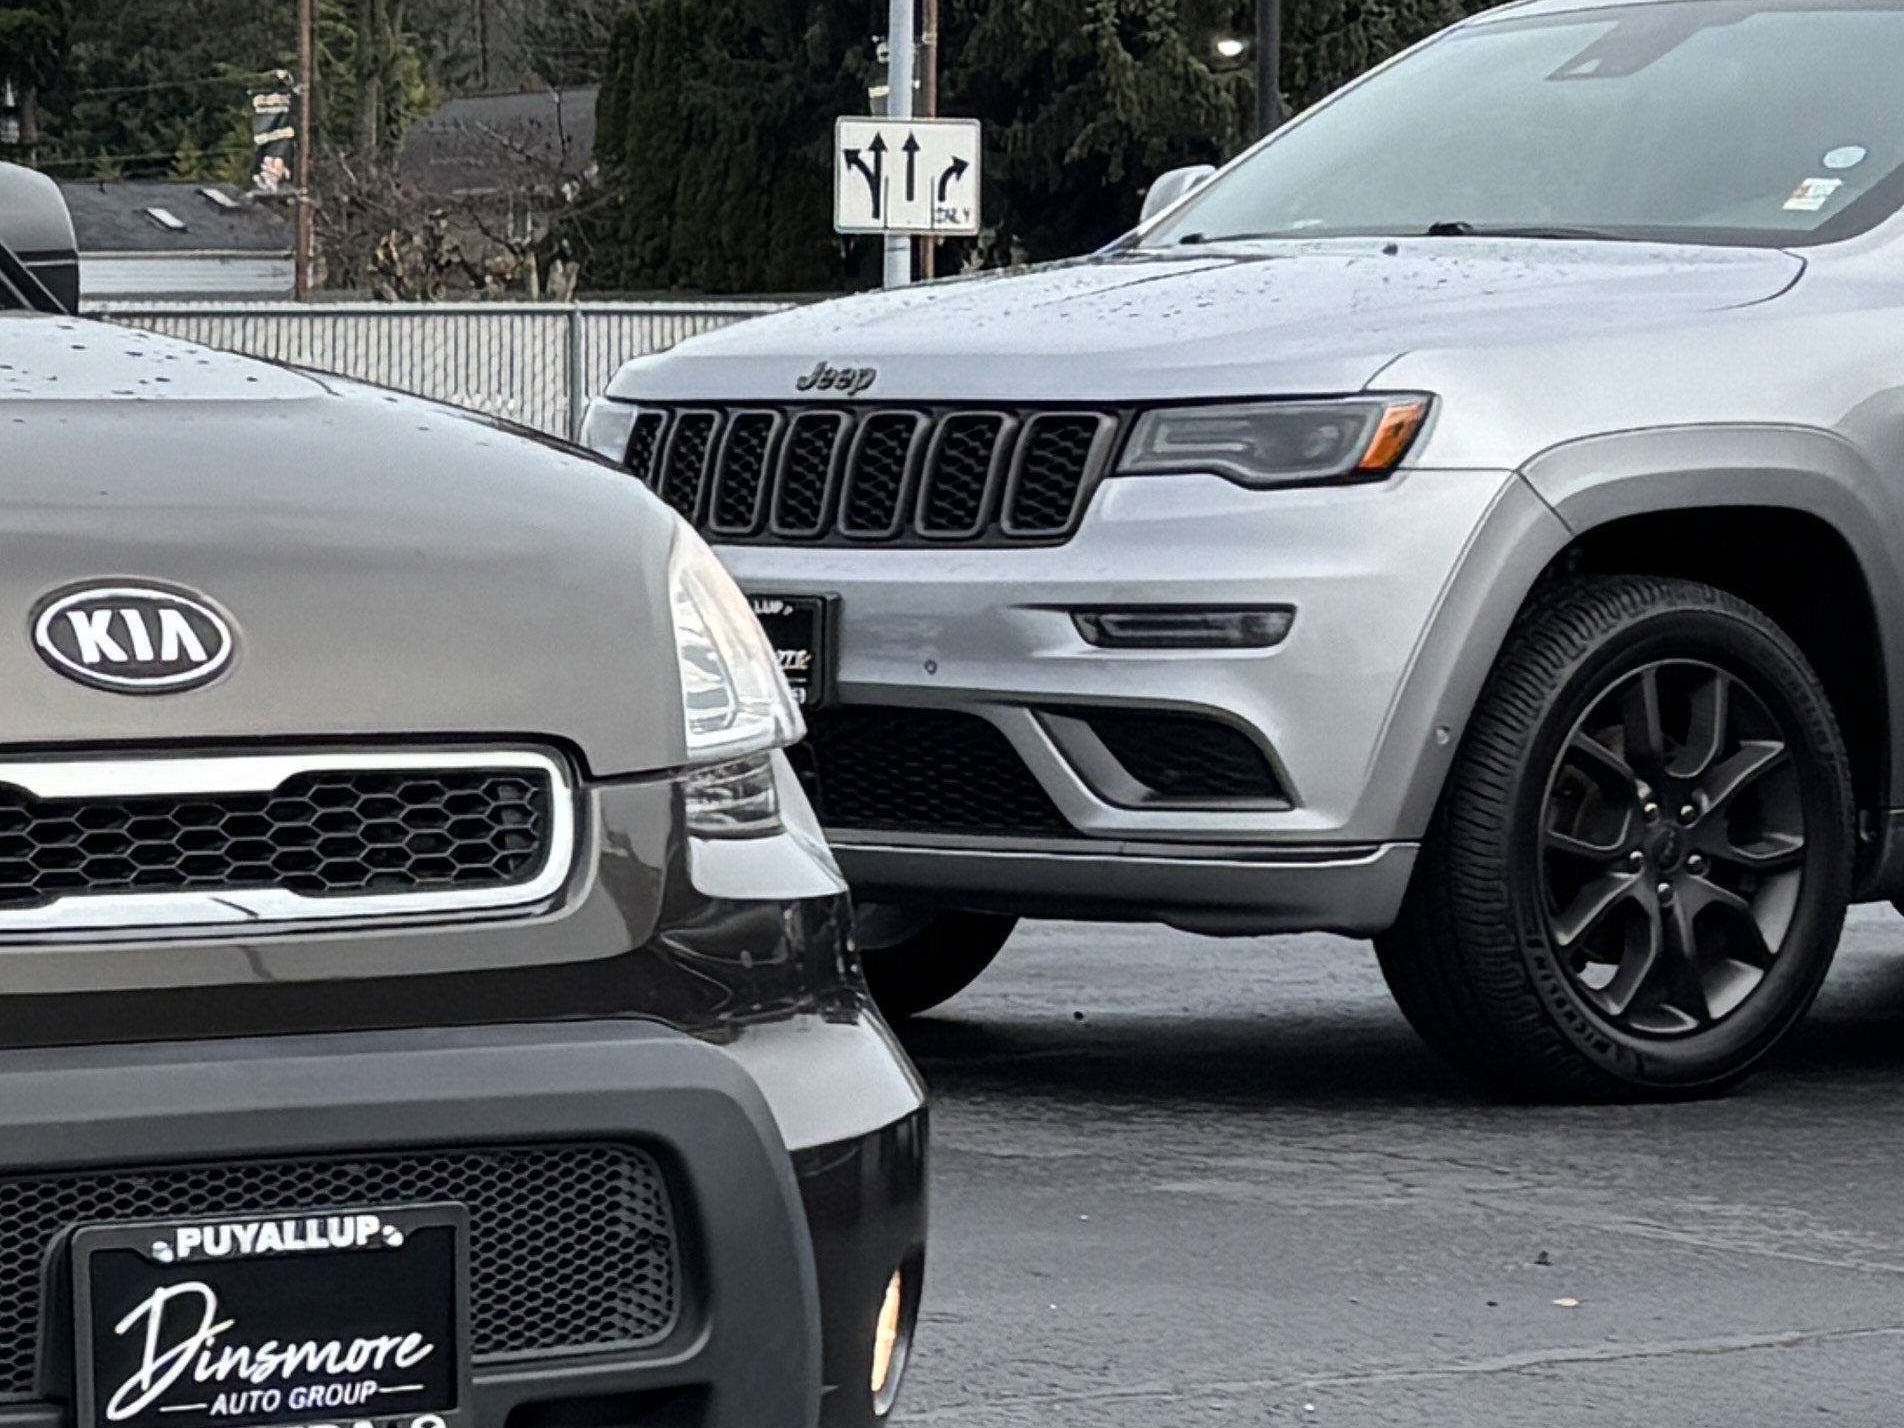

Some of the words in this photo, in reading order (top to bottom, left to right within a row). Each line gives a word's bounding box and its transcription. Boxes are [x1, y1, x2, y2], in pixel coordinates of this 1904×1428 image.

[796, 361, 877, 396] Jeep
[65, 609, 208, 663] KIA
[177, 1216, 381, 1259] PUYALLUP
[106, 1281, 433, 1421] Dinsmore
[210, 1389, 280, 1416] AUTO
[288, 1381, 378, 1410] GROUP
